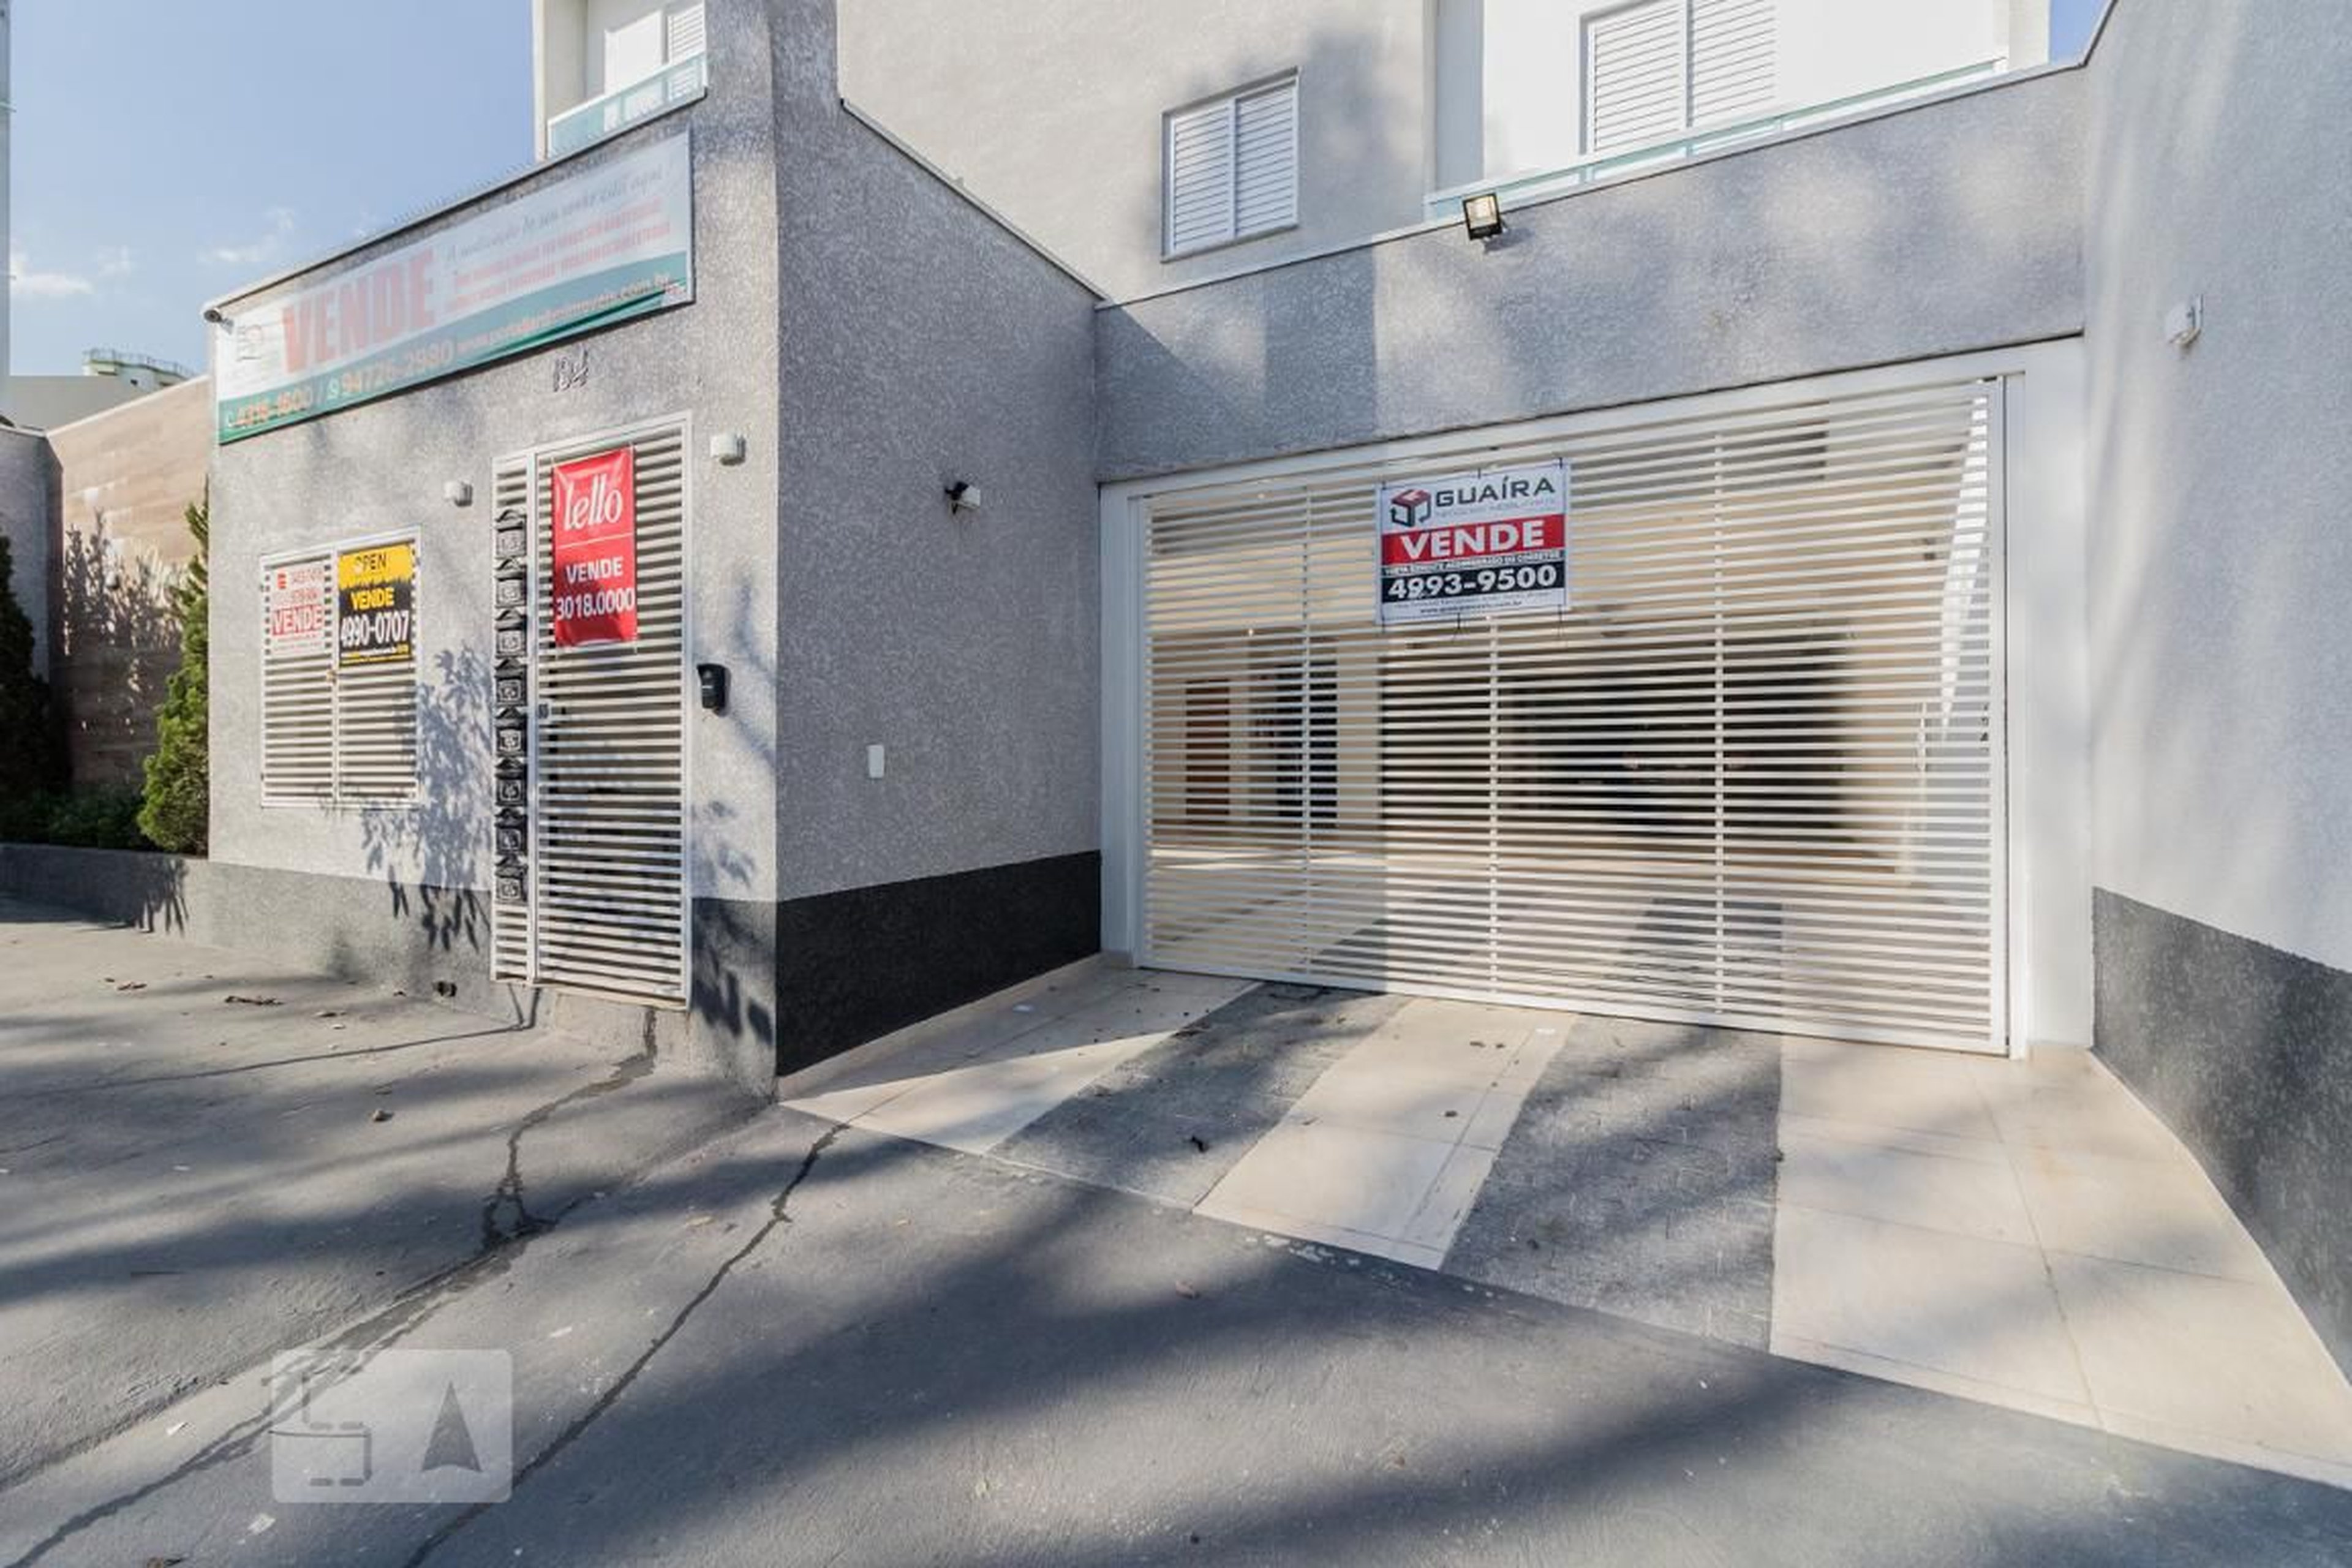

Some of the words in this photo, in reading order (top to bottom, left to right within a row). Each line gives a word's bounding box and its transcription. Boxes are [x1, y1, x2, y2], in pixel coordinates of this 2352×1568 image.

[282, 246, 434, 374] VENDE
[563, 473, 623, 532] lello
[1436, 476, 1556, 508] GUAÍRA
[1400, 520, 1546, 560] VENDE
[565, 556, 624, 584] VENDE
[1388, 564, 1557, 600] 4993-9500
[350, 586, 395, 611] VENDE
[274, 605, 323, 635] VENDE
